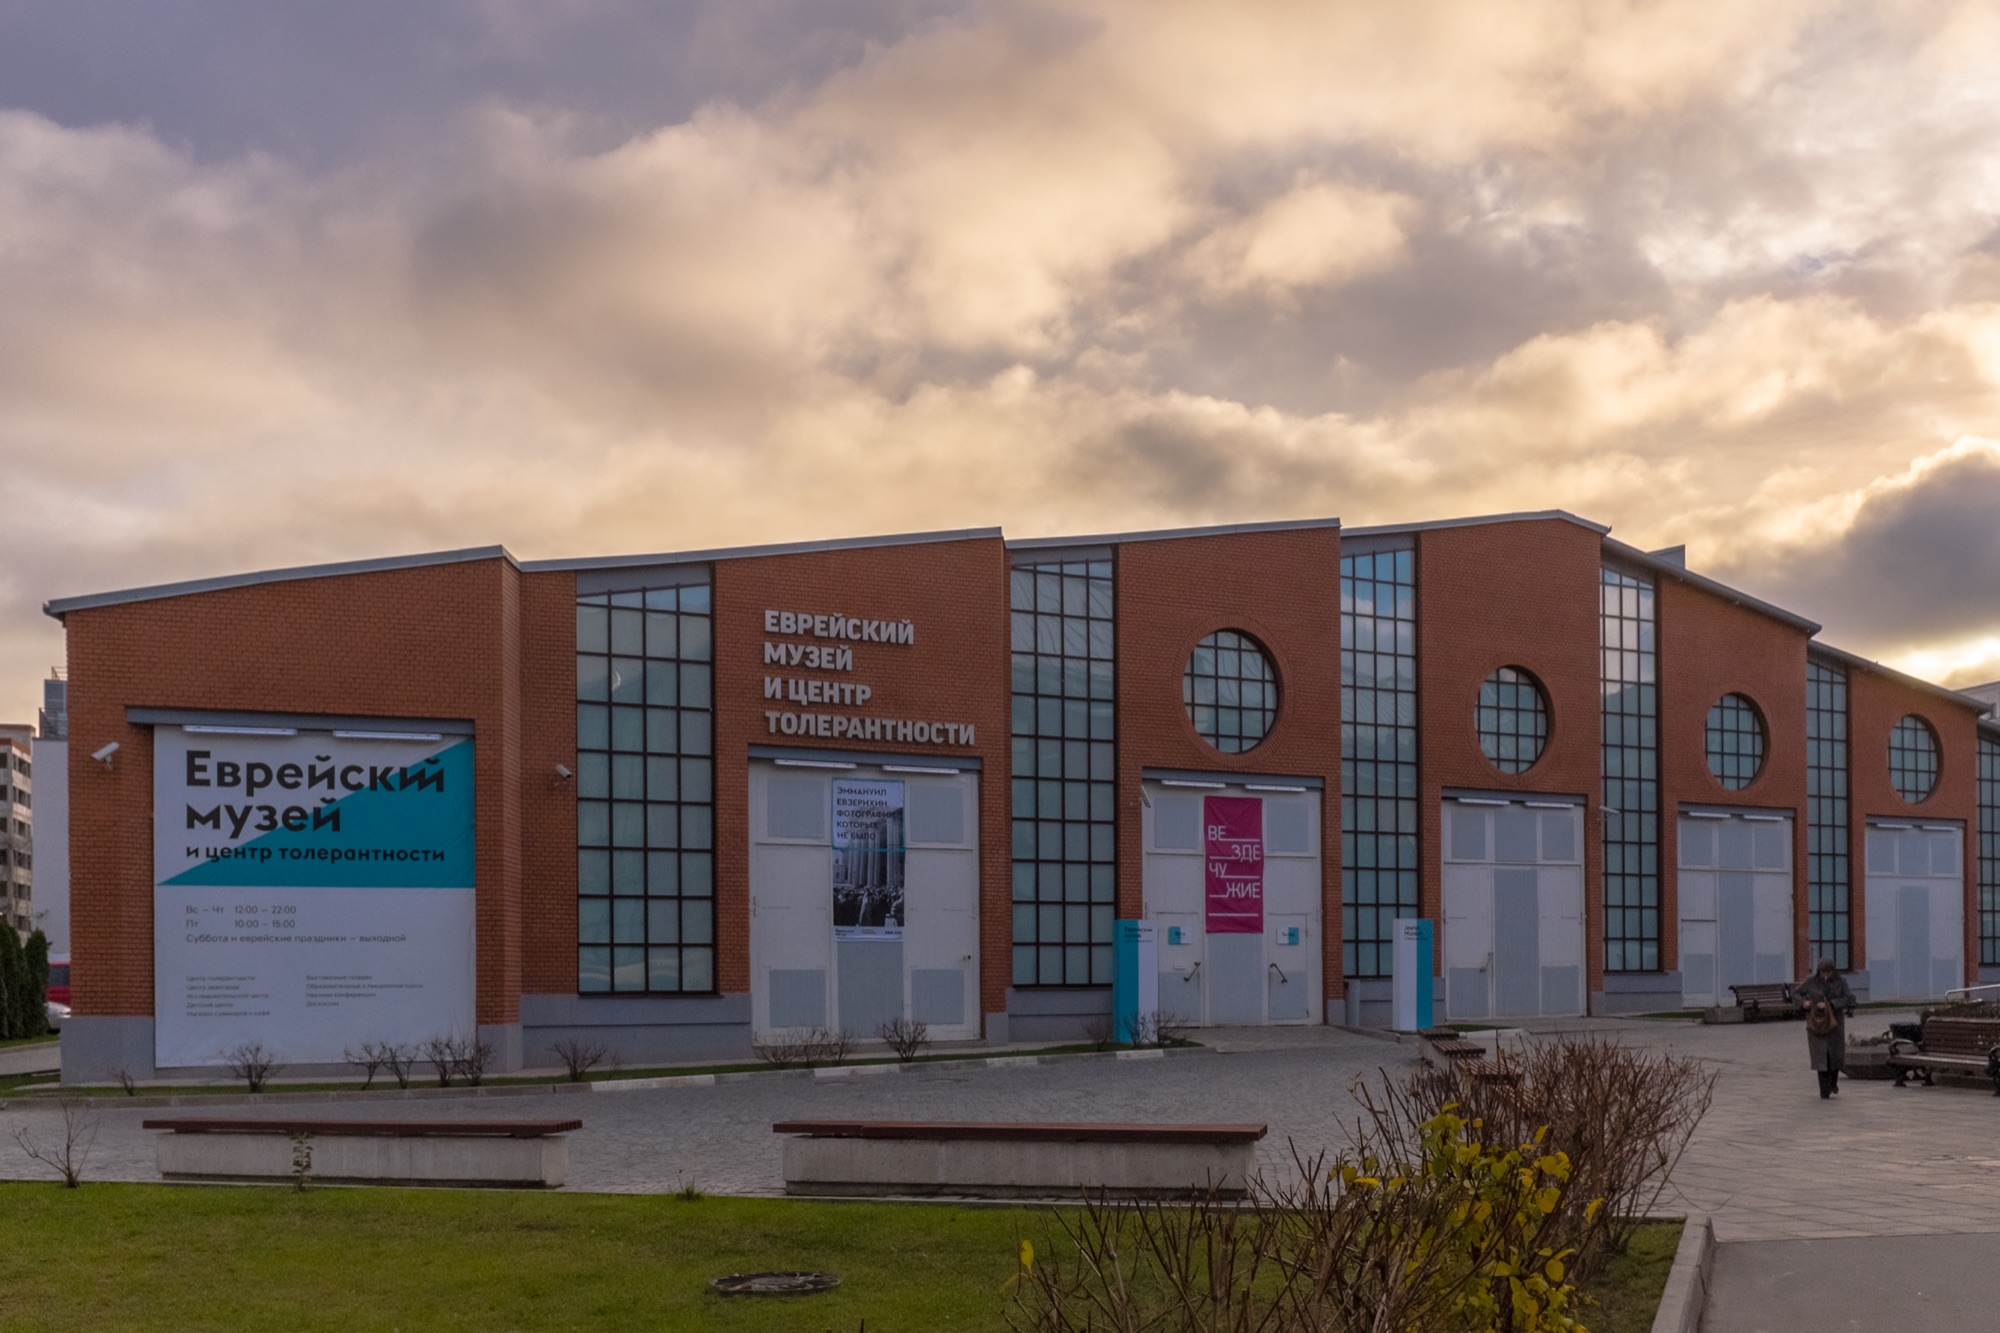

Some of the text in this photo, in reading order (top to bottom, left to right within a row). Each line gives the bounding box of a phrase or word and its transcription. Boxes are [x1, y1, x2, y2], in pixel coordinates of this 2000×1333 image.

[764, 609, 915, 646] ЕВРЕЙСКИЙ
[763, 641, 853, 672] МУЗЕЙ
[763, 676, 872, 706] И ЦЕНТР
[764, 710, 976, 746] ТОЛЕРАНТНОСТИ
[186, 750, 445, 797] Еврейский
[836, 786, 887, 796] ЭММАНУИЛ
[836, 798, 888, 807] ЕВЗЕРИХИН
[186, 797, 341, 839] музей
[836, 820, 879, 829] КОТОРЫХ
[837, 831, 876, 840] НЕ БЫЛО
[186, 846, 445, 864] и центр толерантности
[1231, 844, 1261, 862] ЗДЕ
[1226, 882, 1261, 898] ЖИЕ
[186, 905, 199, 915] Вс
[212, 905, 225, 915] Чт
[234, 905, 259, 915] 12:00
[271, 905, 297, 915] 22:00
[186, 919, 199, 928] Пт
[234, 919, 259, 929] 10:00
[272, 919, 296, 929] 15:00
[186, 933, 229, 944] Суббота
[239, 934, 292, 945] еврейские
[294, 935, 347, 945] праздники
[359, 934, 407, 943] выходной
